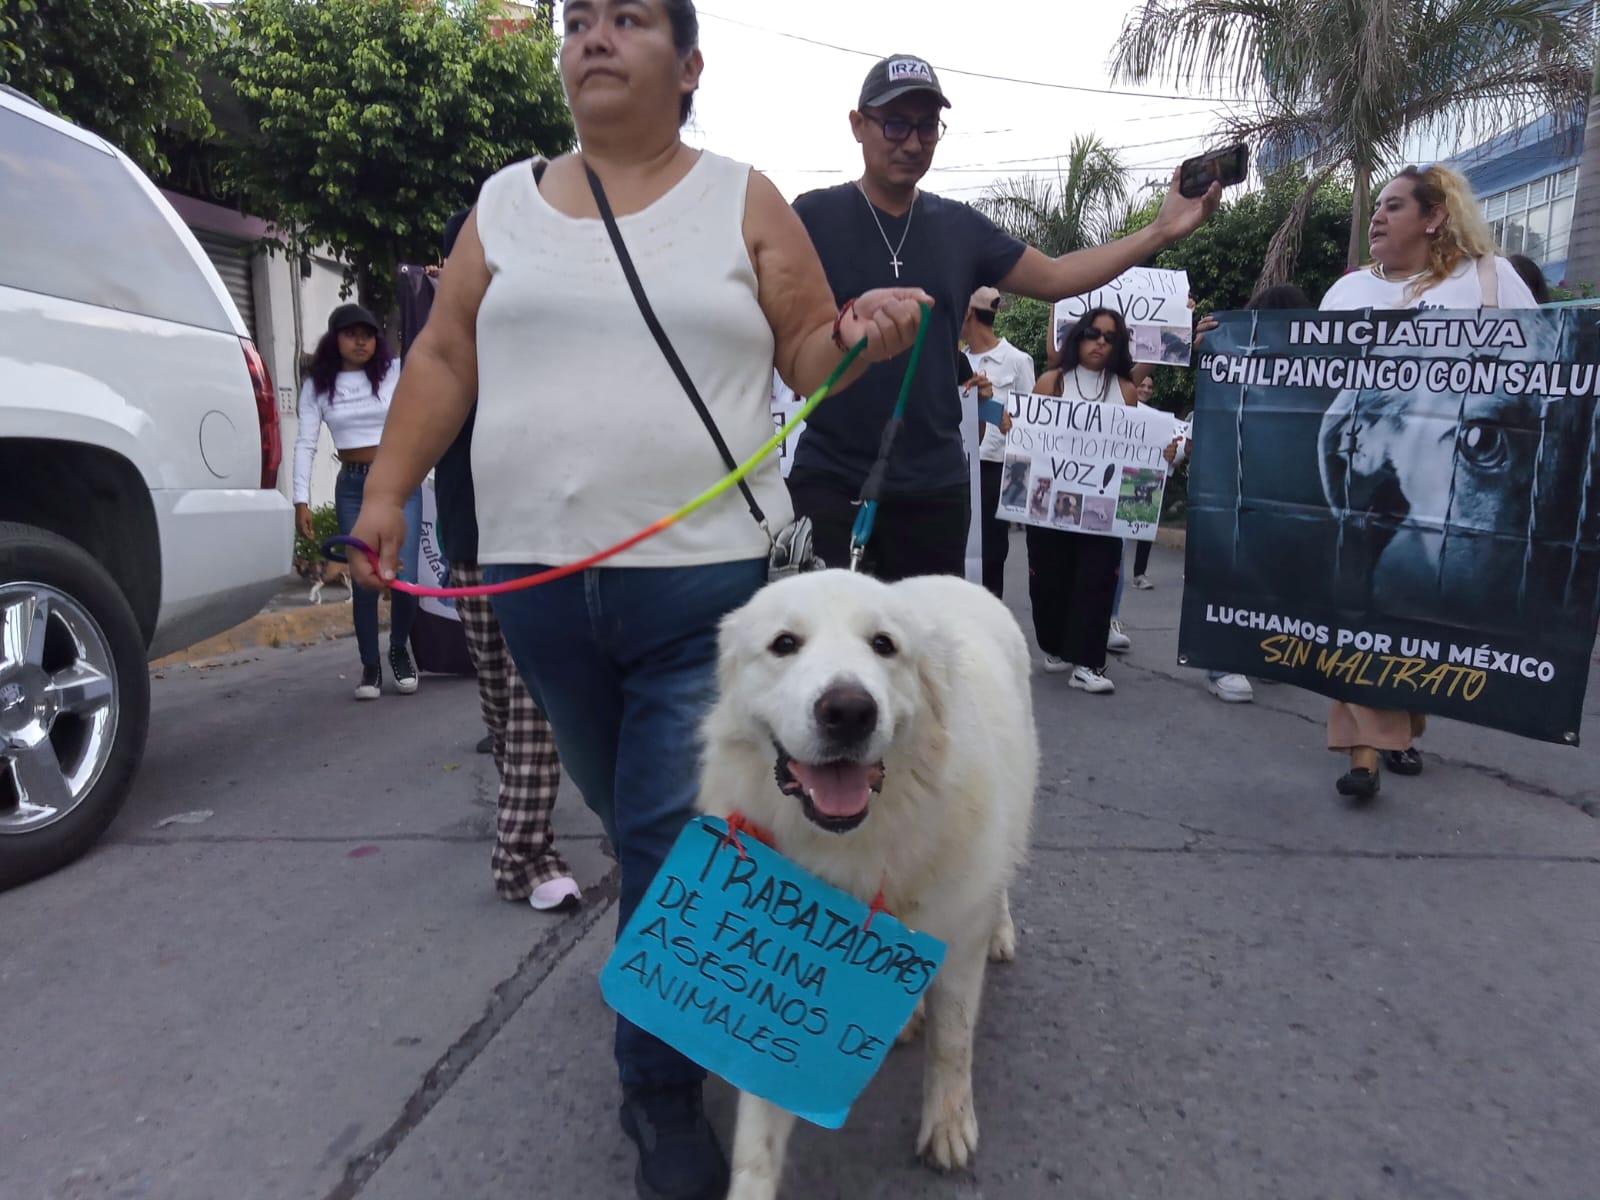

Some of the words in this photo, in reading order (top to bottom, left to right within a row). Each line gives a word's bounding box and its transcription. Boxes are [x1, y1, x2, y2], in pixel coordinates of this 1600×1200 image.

[891, 63, 929, 75] IRZA
[1116, 293, 1169, 323] VOZ
[1288, 319, 1526, 348] INICIATIVA
[1427, 360, 1497, 394] CON
[1504, 361, 1600, 397] SALU
[1009, 391, 1103, 433] JUSTICIA
[1110, 406, 1147, 442] Para
[1038, 432, 1064, 455] que
[1071, 437, 1099, 458] no
[1206, 604, 1330, 645] LUCHAMOS
[1337, 629, 1393, 654] POR
[1400, 637, 1441, 660] UN
[1448, 644, 1555, 682] MÉXICO
[1260, 634, 1312, 668] SIN
[1316, 648, 1487, 701] MALTRATO
[699, 823, 937, 995] TRABAJADORES
[656, 875, 704, 927] DE
[712, 910, 828, 997] FACINA
[639, 916, 829, 1035] ASESINOS
[838, 1024, 885, 1060] DE
